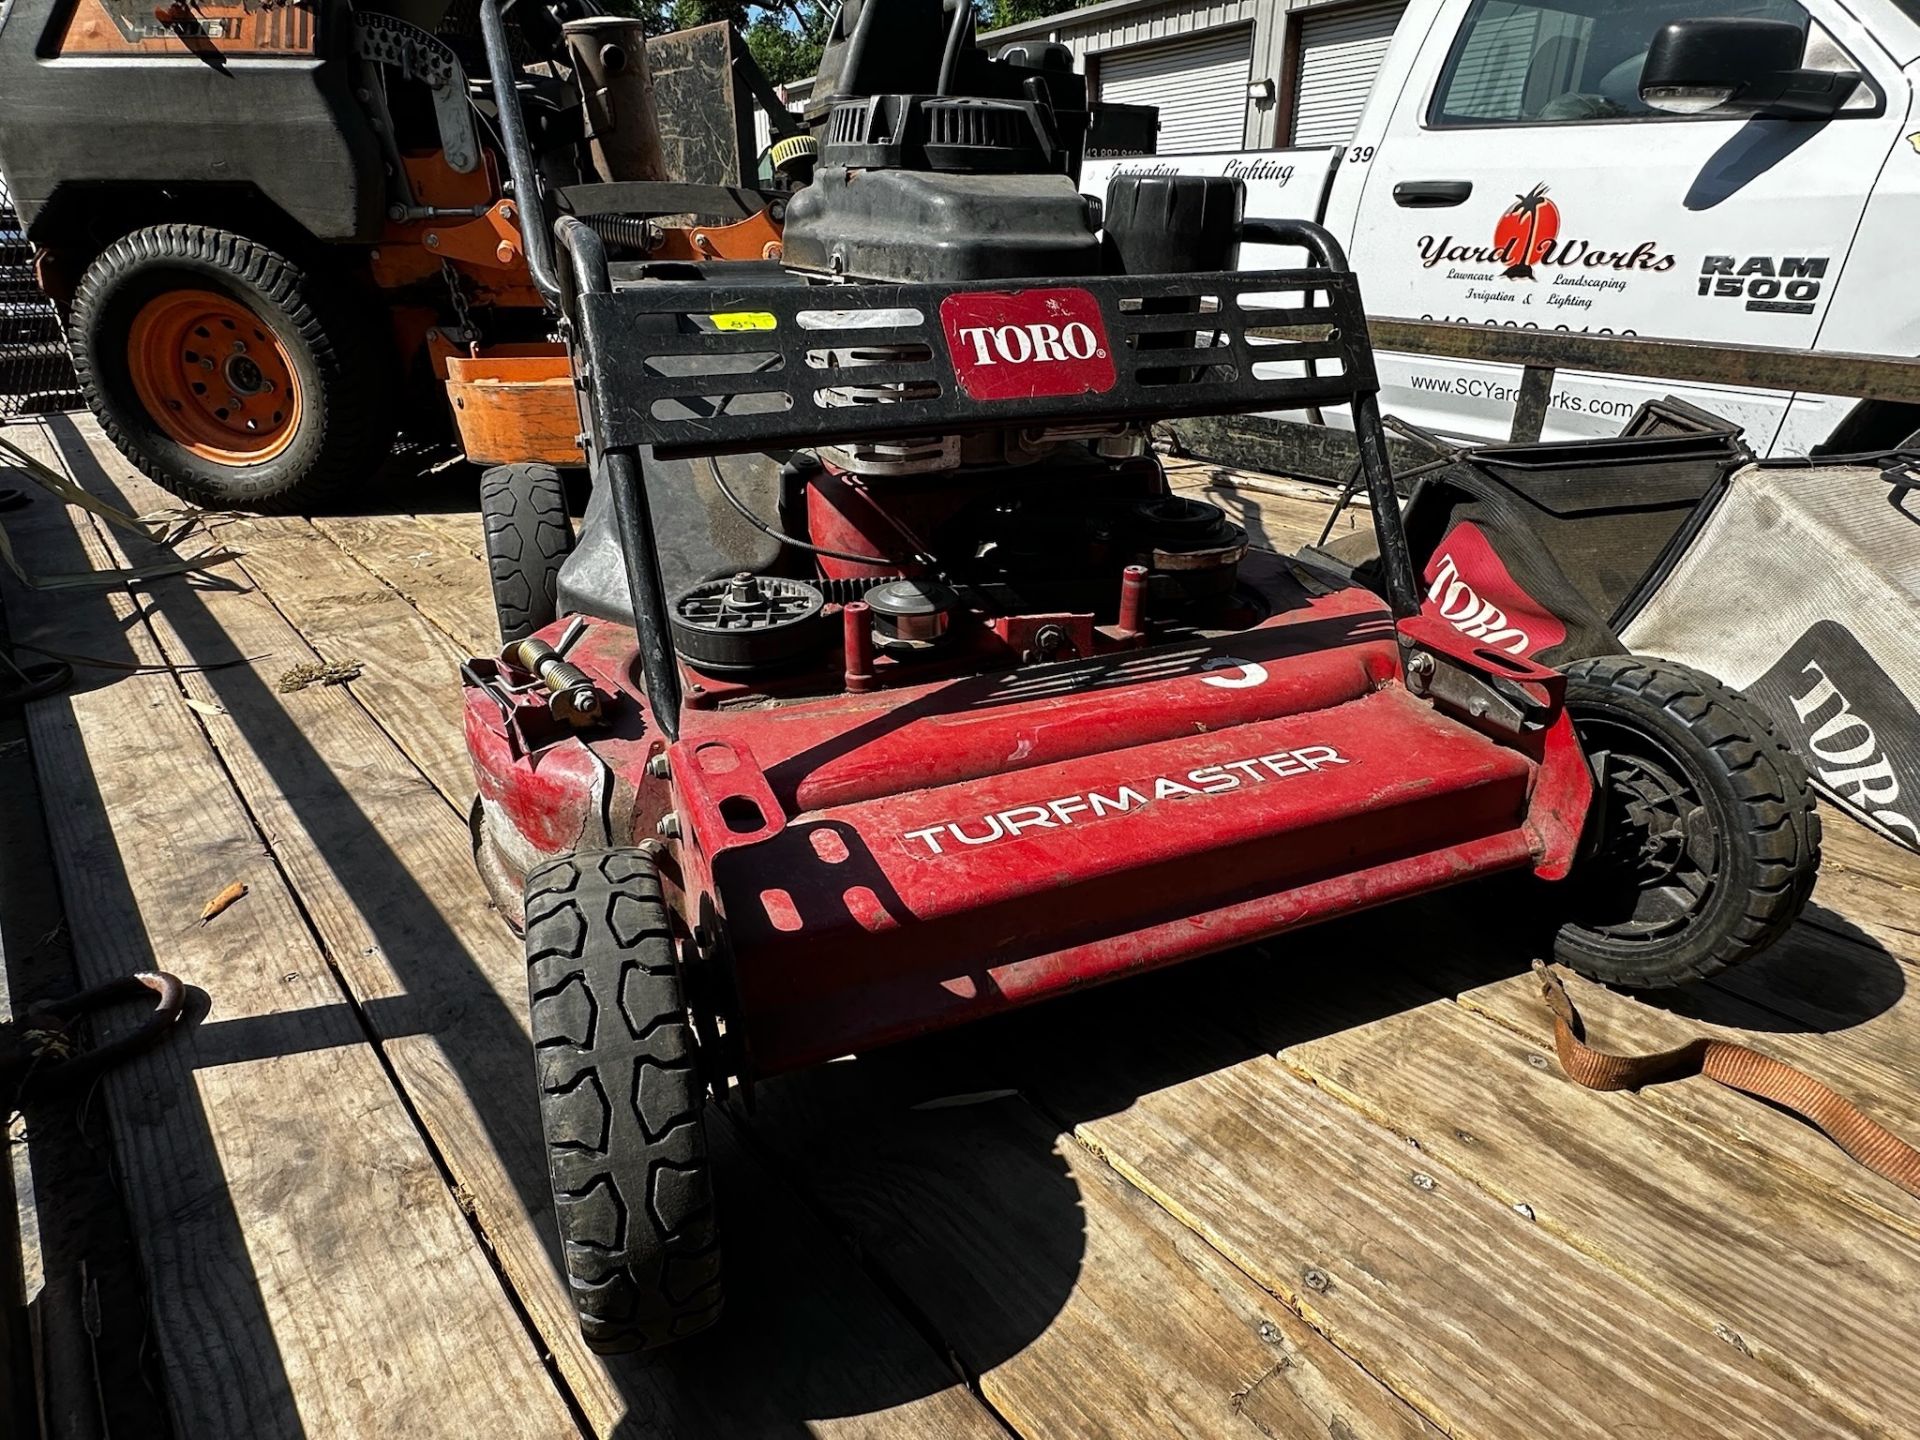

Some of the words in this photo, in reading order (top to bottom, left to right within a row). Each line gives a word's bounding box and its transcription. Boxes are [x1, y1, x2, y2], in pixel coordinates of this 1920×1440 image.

[1349, 146, 1375, 164] 39
[1221, 158, 1296, 188] Lighting
[1417, 235, 1517, 268] Yard
[1536, 238, 1678, 272] Works
[1700, 255, 1830, 279] RAM
[1446, 267, 1495, 282] Lawncare
[1552, 273, 1628, 293] Landscaping
[1698, 277, 1821, 301] 1500
[1465, 287, 1516, 304] Irrigation
[1522, 293, 1532, 305] &
[1546, 293, 1593, 311] Lighting
[1410, 375, 1634, 418] www.SCYarrks.com
[1427, 552, 1530, 655] TORO
[903, 745, 1350, 854] TURFMASTER
